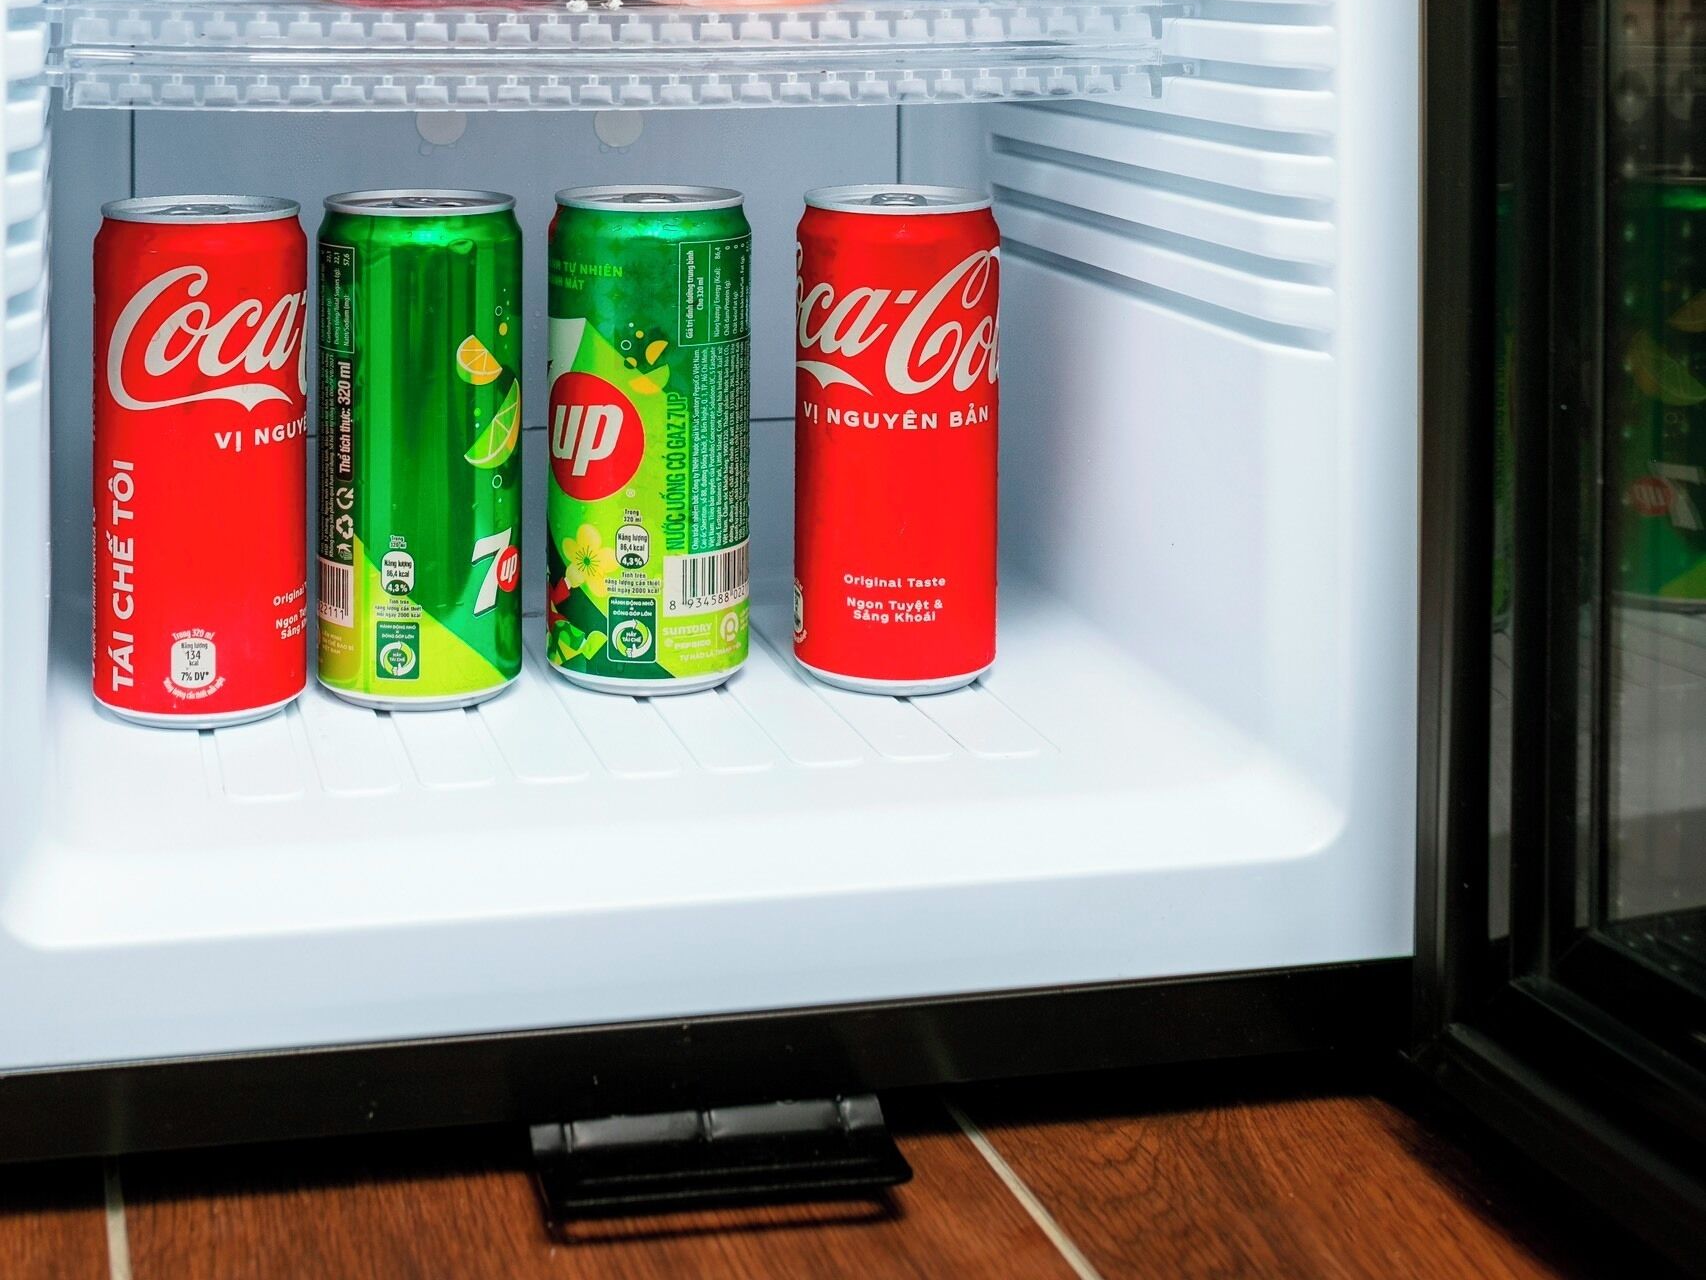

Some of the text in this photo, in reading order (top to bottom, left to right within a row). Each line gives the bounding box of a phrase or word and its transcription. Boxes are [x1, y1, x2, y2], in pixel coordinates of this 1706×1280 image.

[343, 253, 352, 266] 57,6
[713, 246, 721, 260] 86,4
[580, 262, 623, 278] NHIÊN
[686, 264, 695, 283] trung
[697, 276, 704, 286] ml
[338, 361, 351, 379] ml
[338, 380, 351, 406] 320
[803, 400, 989, 431] VỊ NGUYÊN BẢN
[214, 431, 243, 453] VỊ
[338, 434, 351, 453] tích
[552, 404, 624, 477] up
[338, 454, 351, 474] Thể
[658, 392, 686, 550] NƯỚC UỐNG CÓ GAZ 7UP
[633, 544, 645, 552] kcal
[621, 557, 643, 567] 4,3%
[105, 459, 135, 692] TÁI CHẾ TÔI
[471, 527, 518, 618] 7 up
[843, 573, 947, 589] Original Taste
[669, 600, 677, 610] 8
[687, 593, 730, 609] 934588
[846, 596, 944, 613] Ngon Tuyệt &
[275, 614, 298, 630] Ngon
[894, 611, 937, 624] Khoái
[185, 650, 201, 660] 134
[181, 671, 193, 681] 7%
